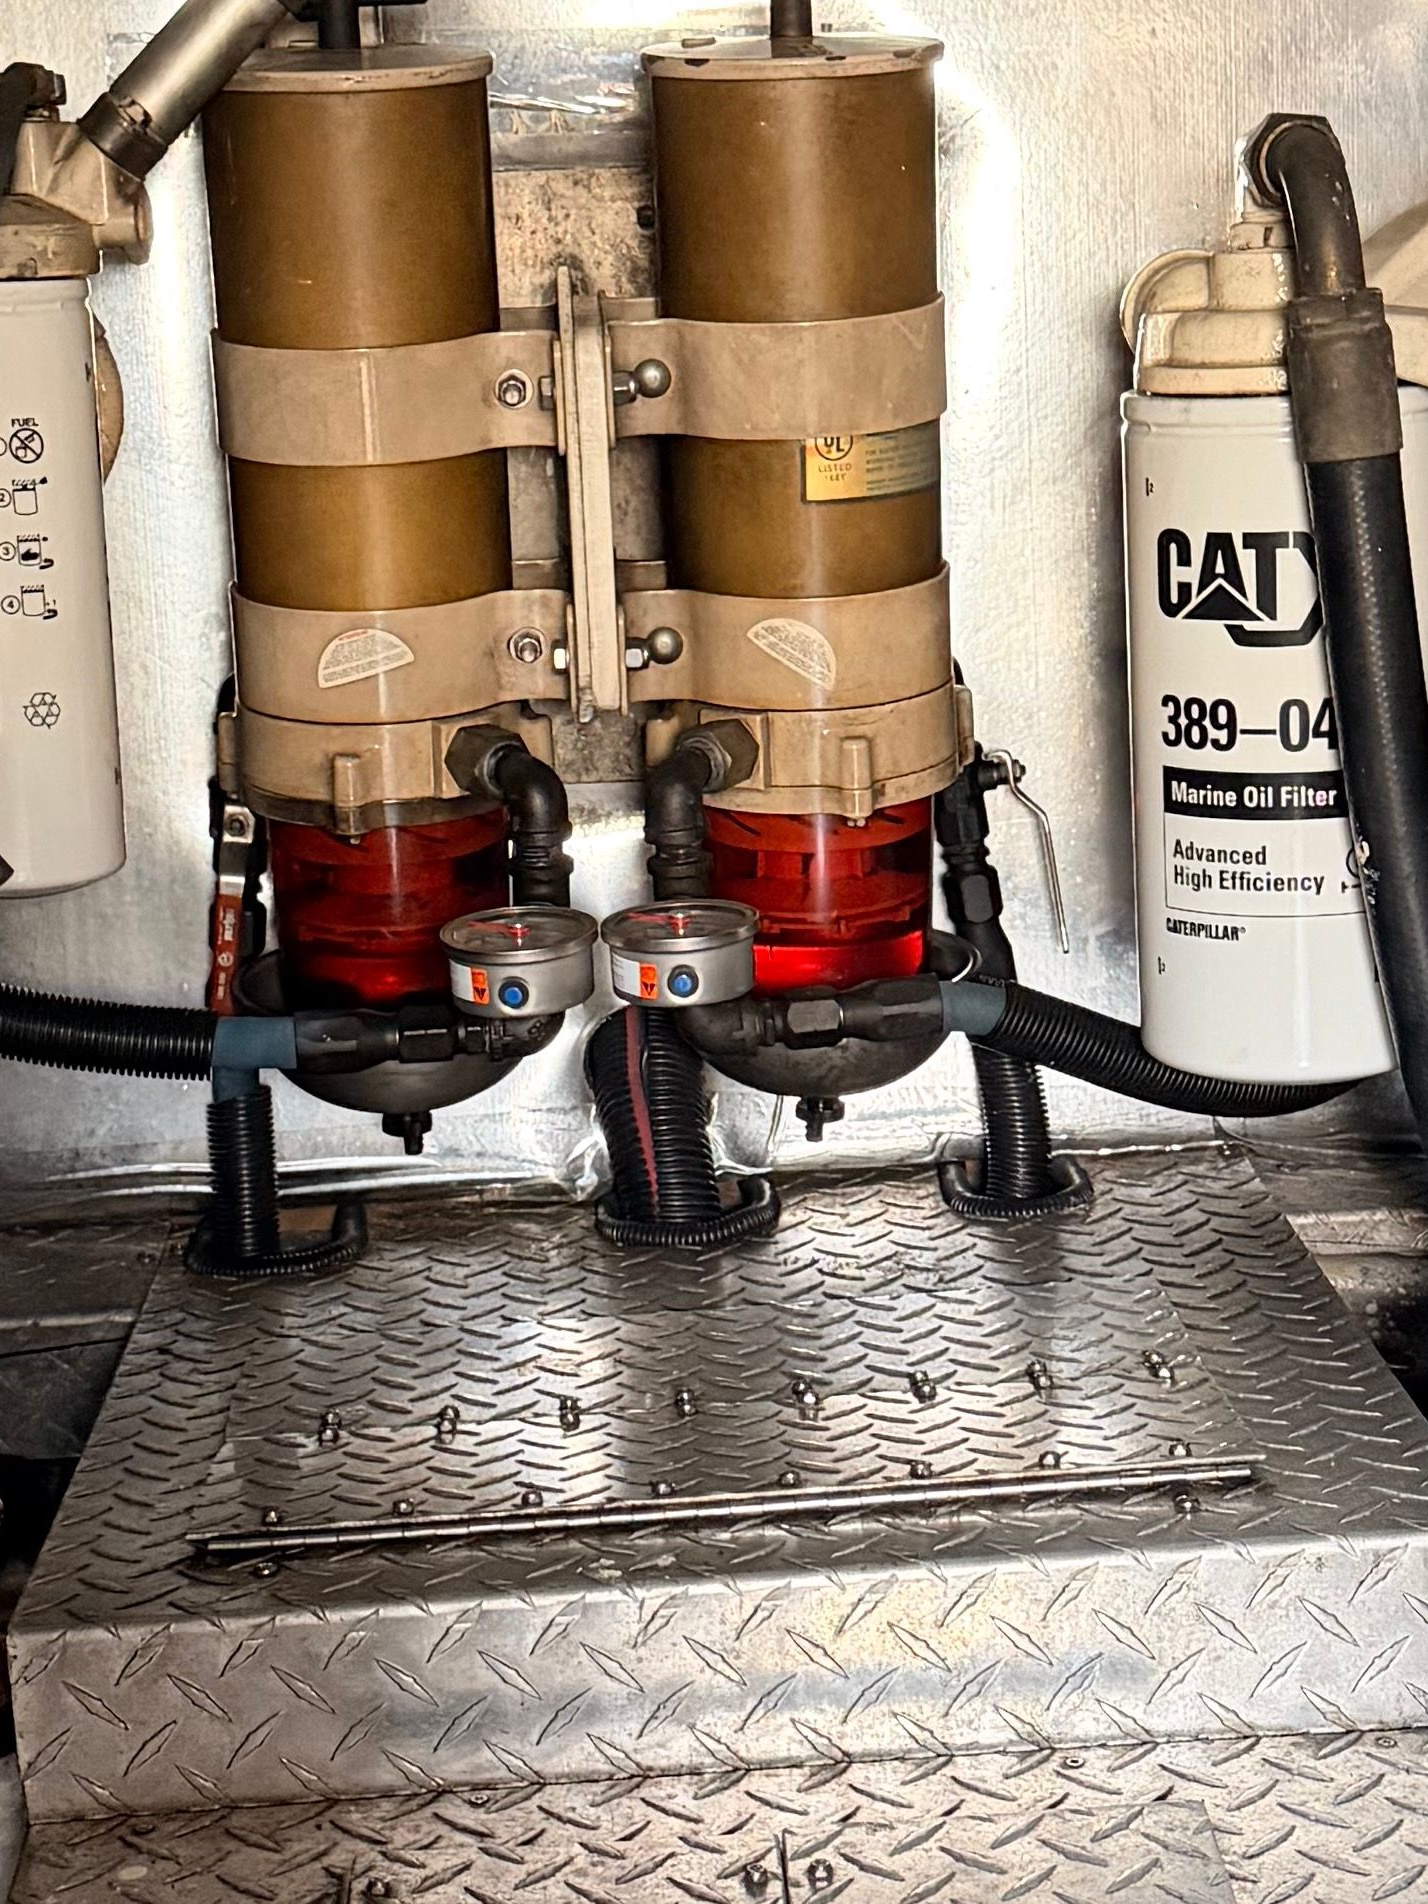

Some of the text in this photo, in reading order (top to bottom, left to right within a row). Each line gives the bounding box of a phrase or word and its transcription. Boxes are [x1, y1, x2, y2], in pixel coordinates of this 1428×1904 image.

[11, 417, 39, 428] FUEL
[1157, 528, 1290, 622] CAT
[1161, 693, 1341, 753] 389-04
[1171, 780, 1338, 808] Marine Oil Filter
[1172, 838, 1268, 866] Advanced
[1173, 863, 1325, 896] High Efficiency
